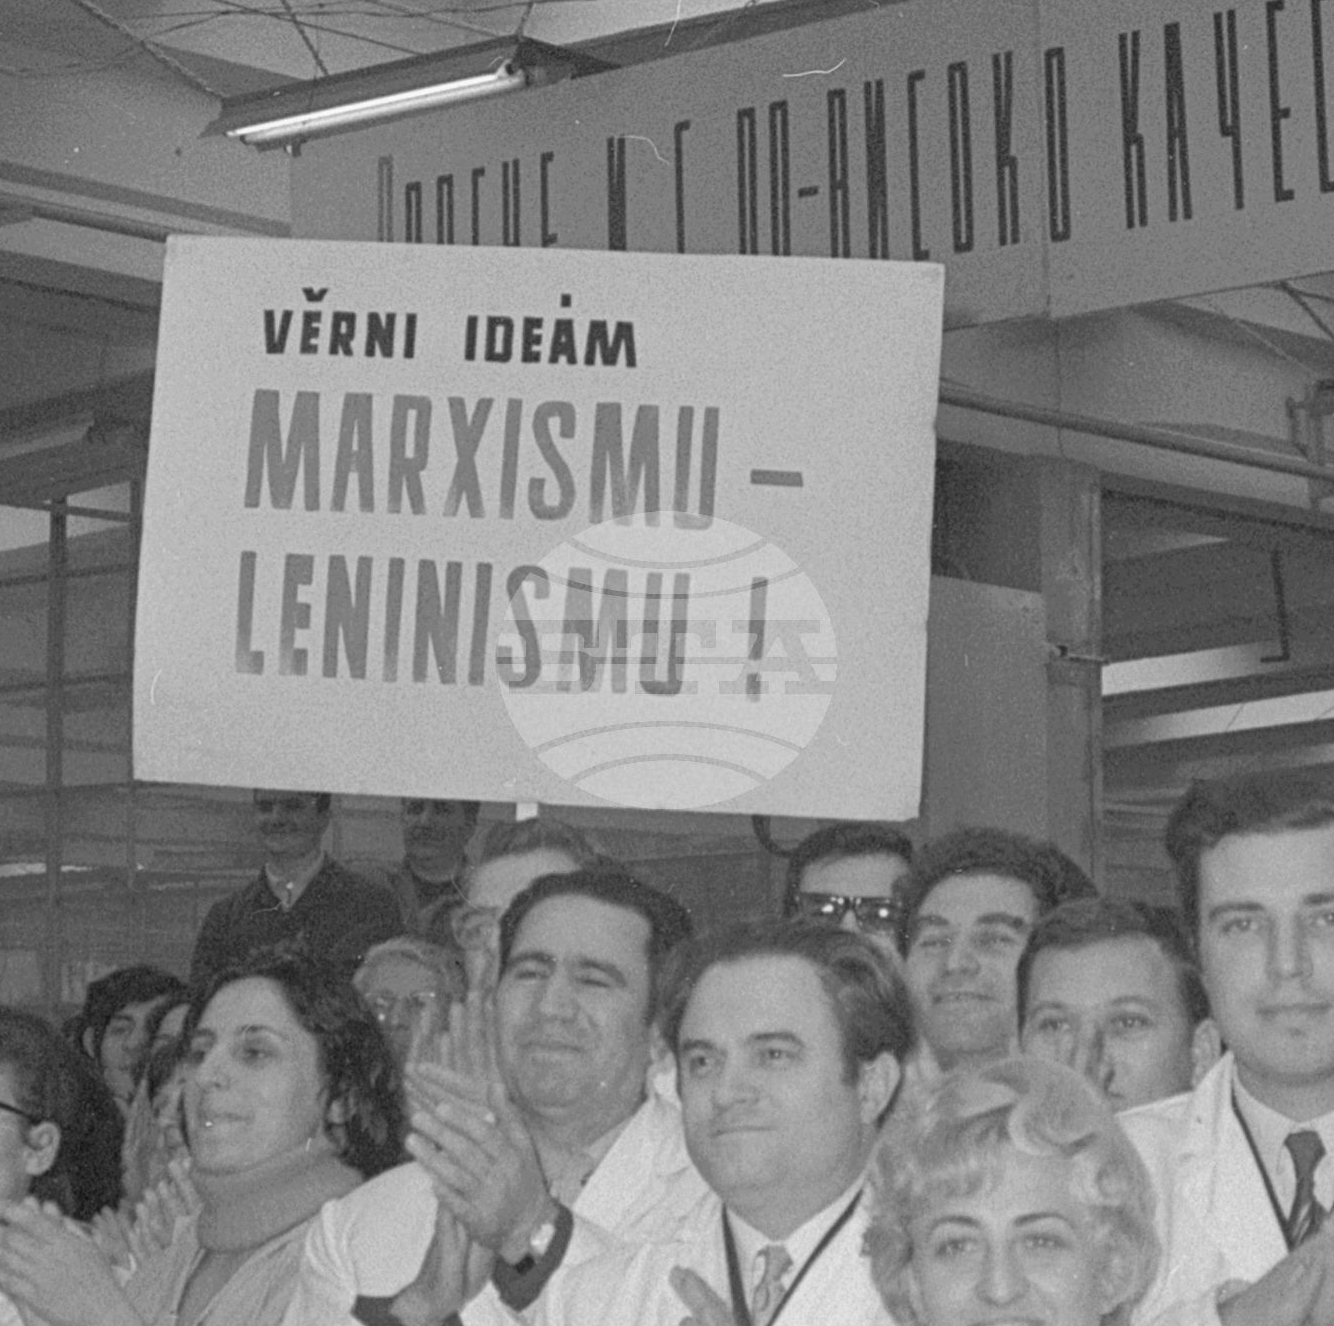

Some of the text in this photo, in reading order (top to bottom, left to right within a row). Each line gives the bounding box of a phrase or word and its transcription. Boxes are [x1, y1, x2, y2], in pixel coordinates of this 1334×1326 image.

[737, 47, 1071, 261] ПО-ВИСОКО
[264, 287, 418, 359] VĚRNI
[235, 550, 691, 696] LENINISMU
